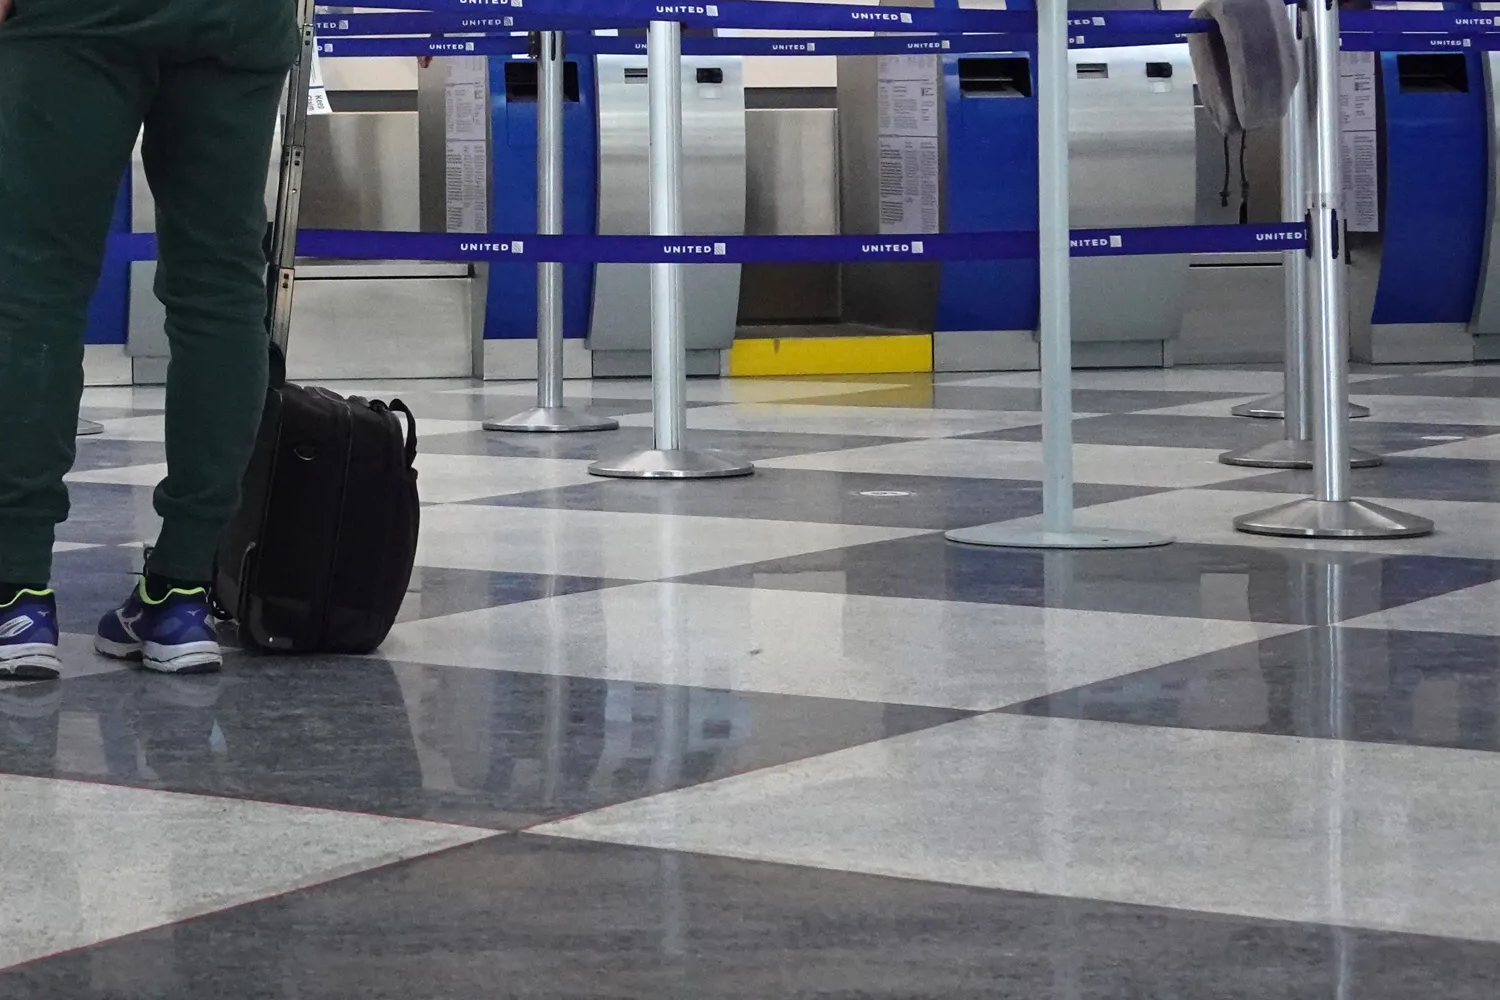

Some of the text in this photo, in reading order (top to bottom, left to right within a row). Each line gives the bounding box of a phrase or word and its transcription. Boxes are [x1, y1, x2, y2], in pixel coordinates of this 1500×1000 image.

[656, 5, 704, 14] UNITED
[851, 12, 899, 21] UNITED
[1256, 232, 1303, 241] UNITED
[460, 243, 509, 251] UNITED
[1070, 238, 1108, 247] NITED
[663, 245, 712, 253] UNITED
[862, 244, 909, 253] UNITED
